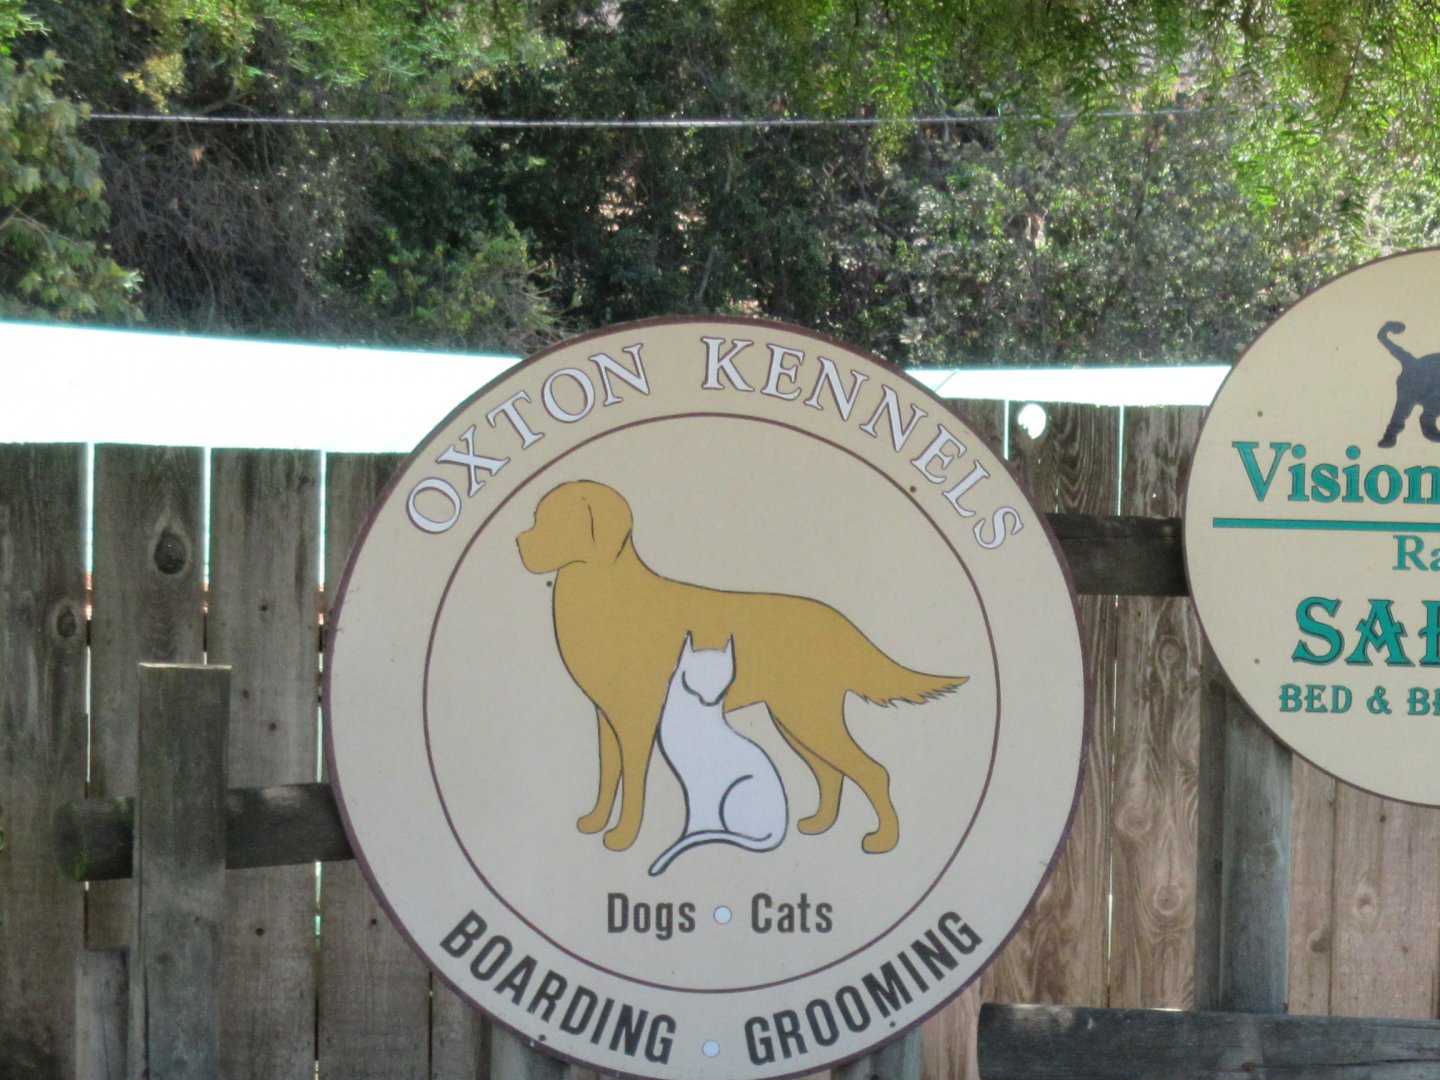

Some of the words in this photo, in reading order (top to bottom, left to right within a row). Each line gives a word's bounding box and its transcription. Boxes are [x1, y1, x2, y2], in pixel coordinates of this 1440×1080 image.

[406, 342, 651, 534] OXTON
[700, 336, 1024, 550] KENNELS
[1279, 684, 1353, 714] BED
[1367, 685, 1393, 714] &
[607, 892, 696, 941] Dogs
[751, 892, 833, 934] Cats
[440, 909, 677, 1066] BOARDING
[744, 910, 983, 1066] GROOMING
